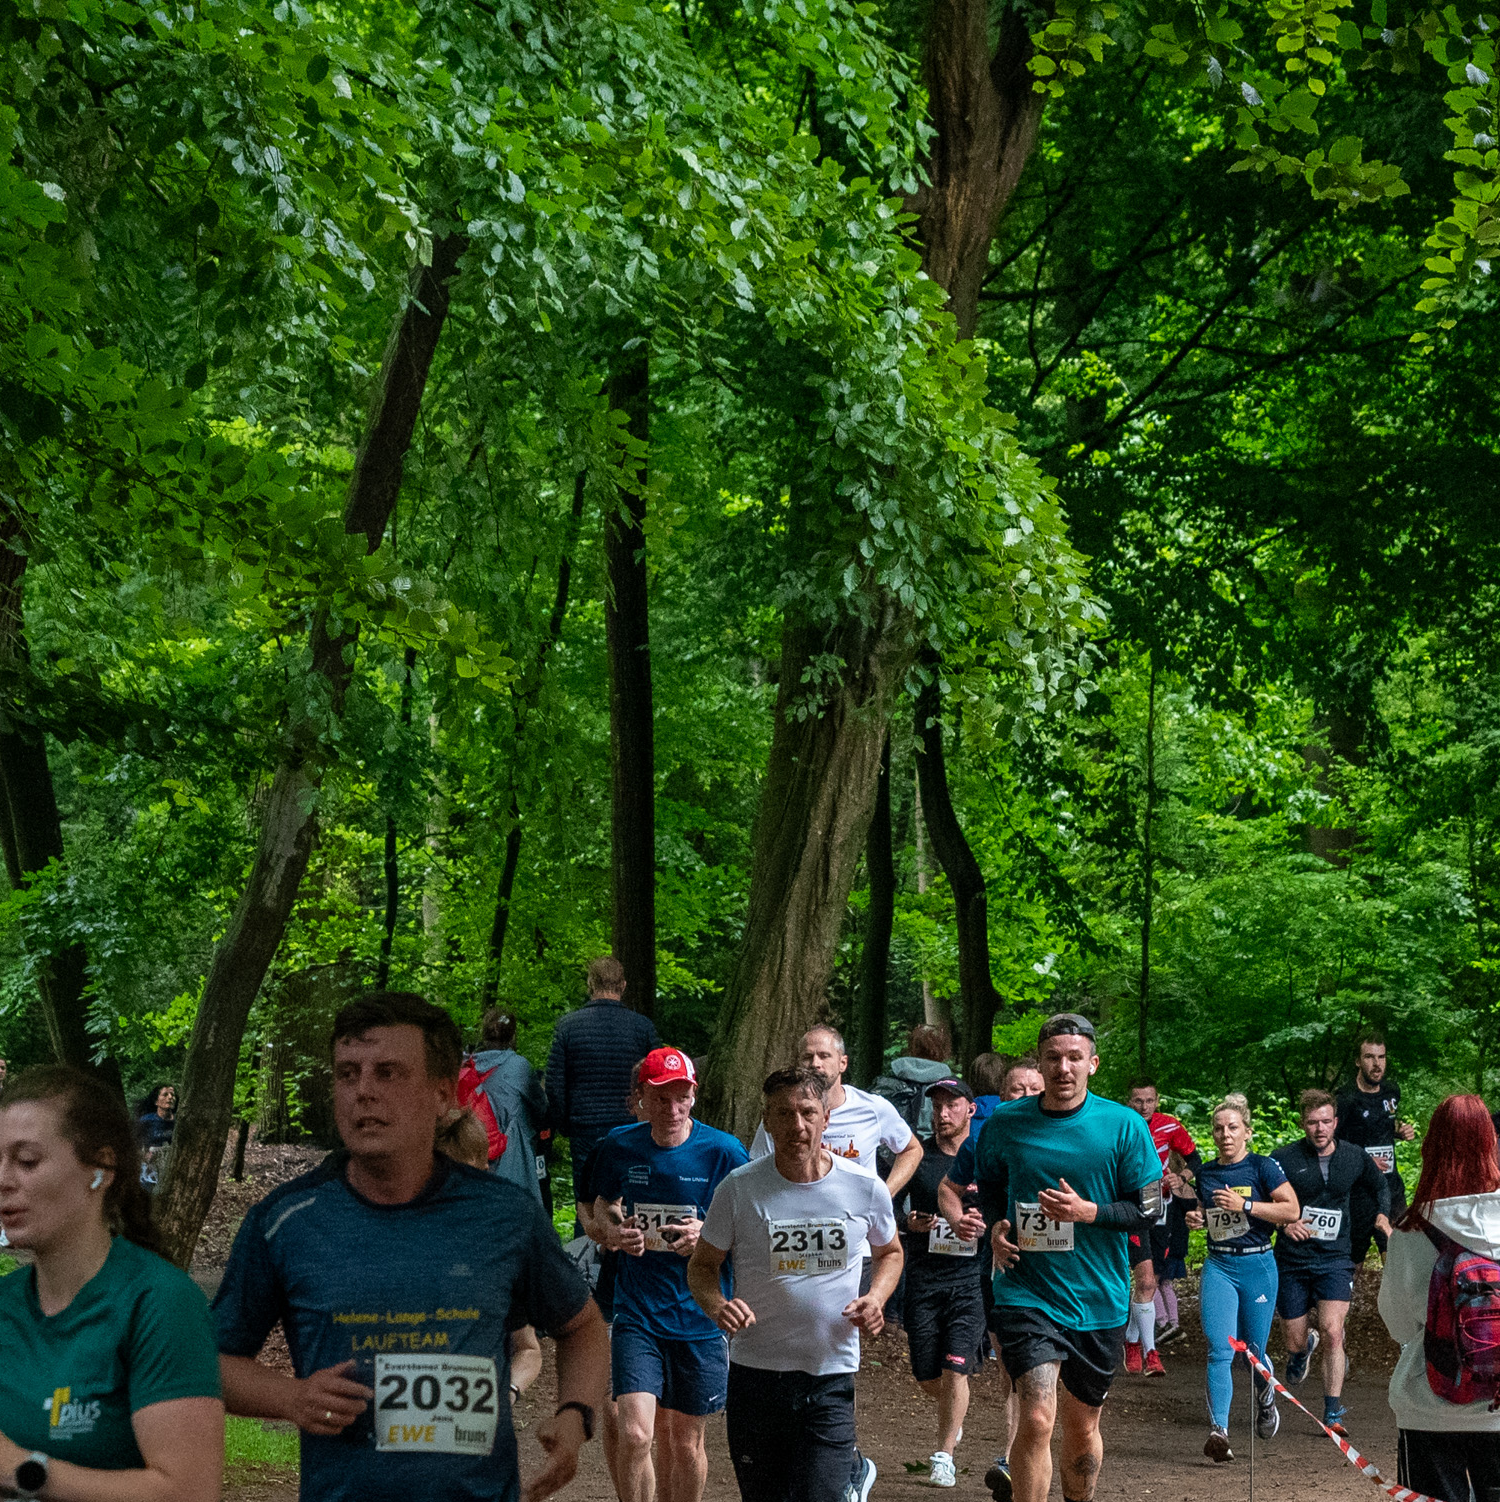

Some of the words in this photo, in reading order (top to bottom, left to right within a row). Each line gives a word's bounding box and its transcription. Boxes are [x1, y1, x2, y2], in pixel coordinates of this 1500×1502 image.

[1212, 1211, 1242, 1228] 793
[1308, 1213, 1337, 1228] 760
[772, 1229, 846, 1253] 2313
[1047, 1237, 1069, 1246] bruns
[778, 1259, 806, 1271] EWE
[817, 1257, 842, 1268] bruns
[351, 1331, 449, 1350] LAUFTEAM
[378, 1374, 495, 1414] 2032
[388, 1425, 437, 1443] EWE
[454, 1425, 487, 1443] bruns
